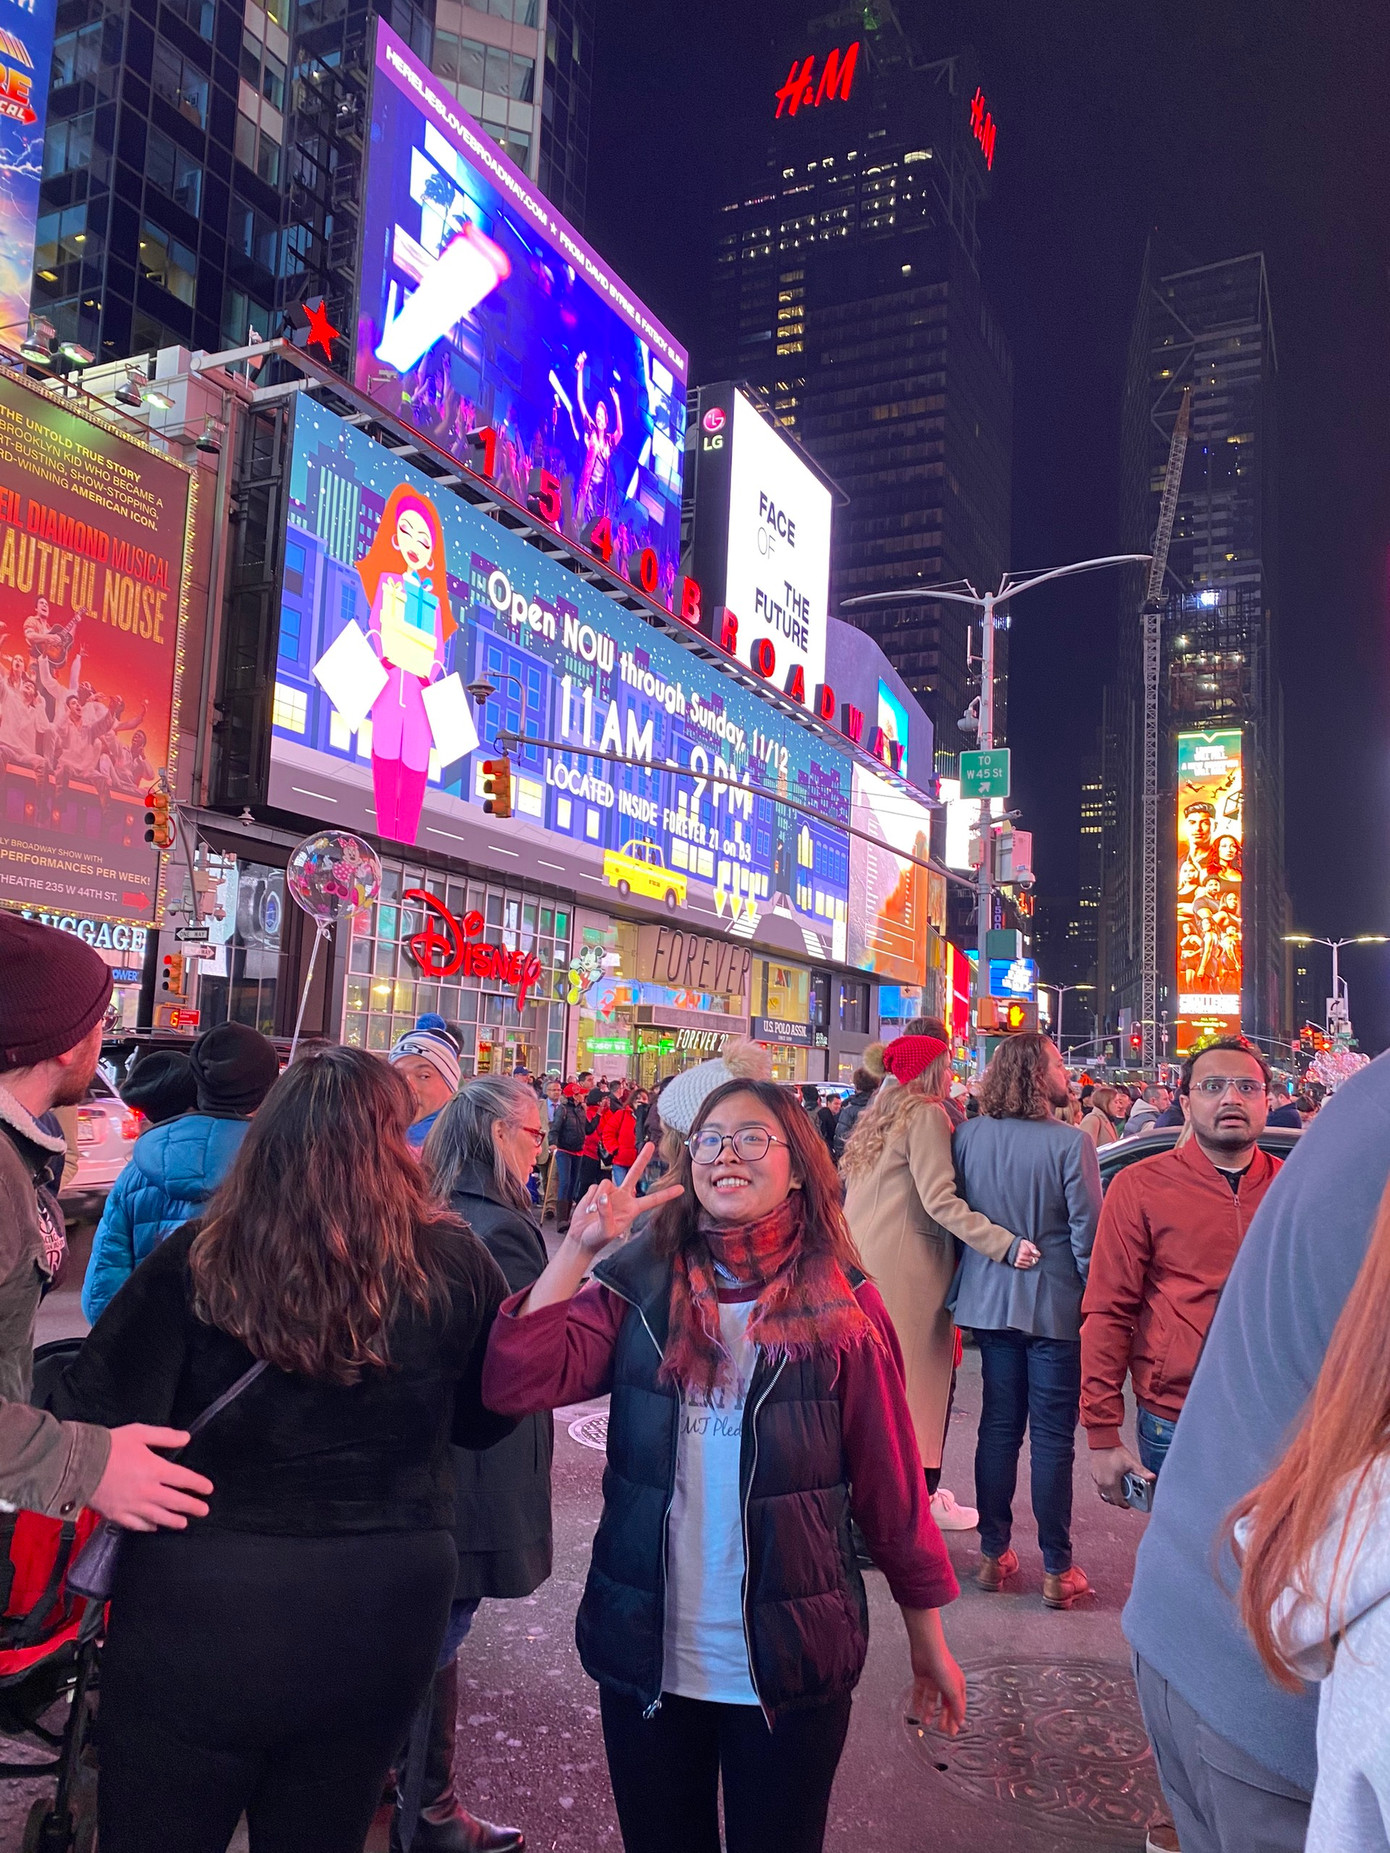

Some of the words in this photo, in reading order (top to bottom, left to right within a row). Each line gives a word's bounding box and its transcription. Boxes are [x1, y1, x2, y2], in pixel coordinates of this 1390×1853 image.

[774, 41, 860, 119] H&M
[559, 231, 585, 266] FROM
[585, 258, 609, 290] DAVID
[0, 405, 23, 424] THE
[26, 420, 73, 449] UNTOLD
[75, 443, 104, 466] TRUE
[105, 459, 141, 483] STORY
[0, 419, 61, 458] BROOKLYN
[63, 451, 82, 467] KID
[85, 461, 111, 482] WHO
[113, 475, 154, 504] BECAME
[156, 498, 163, 509] A
[703, 435, 724, 451] LG
[70, 468, 159, 520] SHOW-STOPPING,
[70, 483, 129, 518] AMERICAN
[130, 511, 158, 531] ICON.
[759, 490, 796, 548] FACE
[27, 498, 110, 564] DIAMOND
[111, 537, 170, 591] MUSICAL
[757, 527, 776, 560] OF
[102, 568, 168, 645] NOISE
[755, 587, 809, 653] FUTURE
[784, 579, 810, 625] THE
[488, 570, 556, 641] Open
[562, 612, 615, 673] NOW
[620, 651, 685, 716] through
[690, 692, 746, 753] Sunday,
[753, 728, 789, 775] 11/12
[966, 769, 975, 779] W
[976, 768, 990, 779] 45
[992, 768, 1002, 778] St
[978, 755, 991, 766] TO
[546, 758, 614, 809] LOCATED
[618, 789, 658, 827] INSIDE
[663, 808, 706, 848] FOREVER
[709, 828, 719, 850] 21
[722, 840, 736, 858] on
[0, 849, 94, 875] PERFORMANCES
[96, 867, 117, 879] PER
[119, 871, 151, 886] WEEK!
[11, 840, 58, 855] BROADWAY
[58, 848, 83, 860] SHOW
[83, 854, 103, 863] WITH
[45, 881, 64, 893] 235
[66, 885, 76, 895] W
[78, 887, 103, 900] 44TH
[104, 892, 118, 902] ST.
[652, 925, 752, 997] FOREVER
[676, 1029, 718, 1052] FOREVER
[763, 1020, 774, 1033] U.S.
[774, 1022, 790, 1036] POLO
